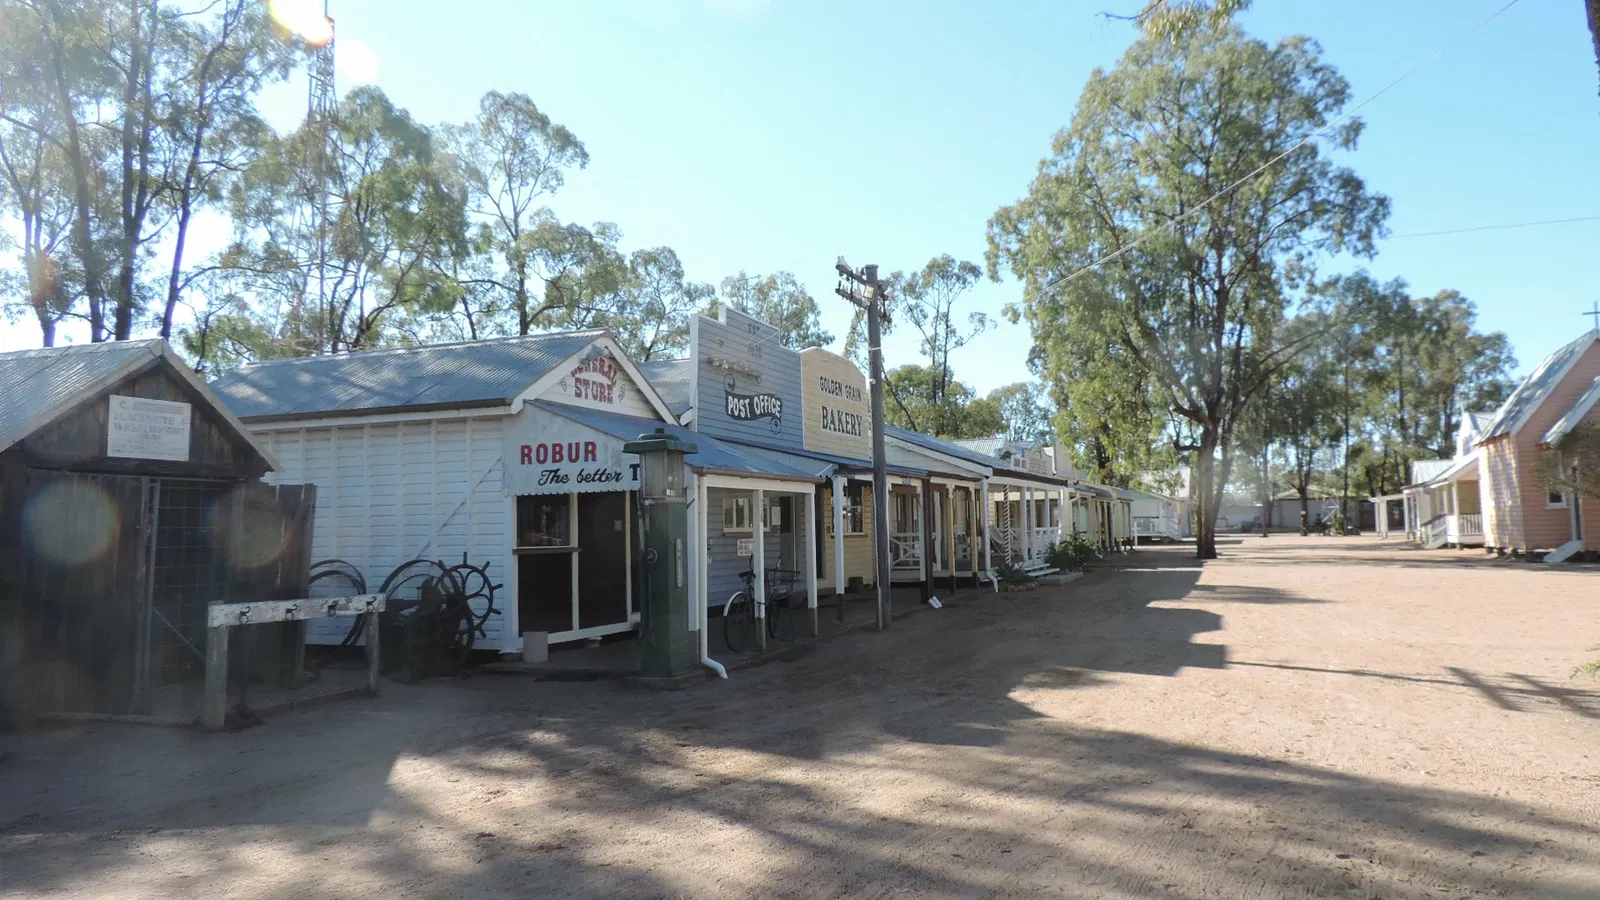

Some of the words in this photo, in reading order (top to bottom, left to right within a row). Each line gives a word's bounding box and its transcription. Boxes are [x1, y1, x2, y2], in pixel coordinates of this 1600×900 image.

[574, 377, 614, 404] STORE
[819, 376, 843, 397] GOLDEN
[844, 384, 862, 402] GRAIN
[728, 395, 750, 418] POST
[753, 395, 781, 417] OFFICE
[821, 405, 862, 437] BAKERY
[520, 441, 597, 465] ROBUR
[538, 468, 570, 486] The
[576, 468, 623, 483] better
